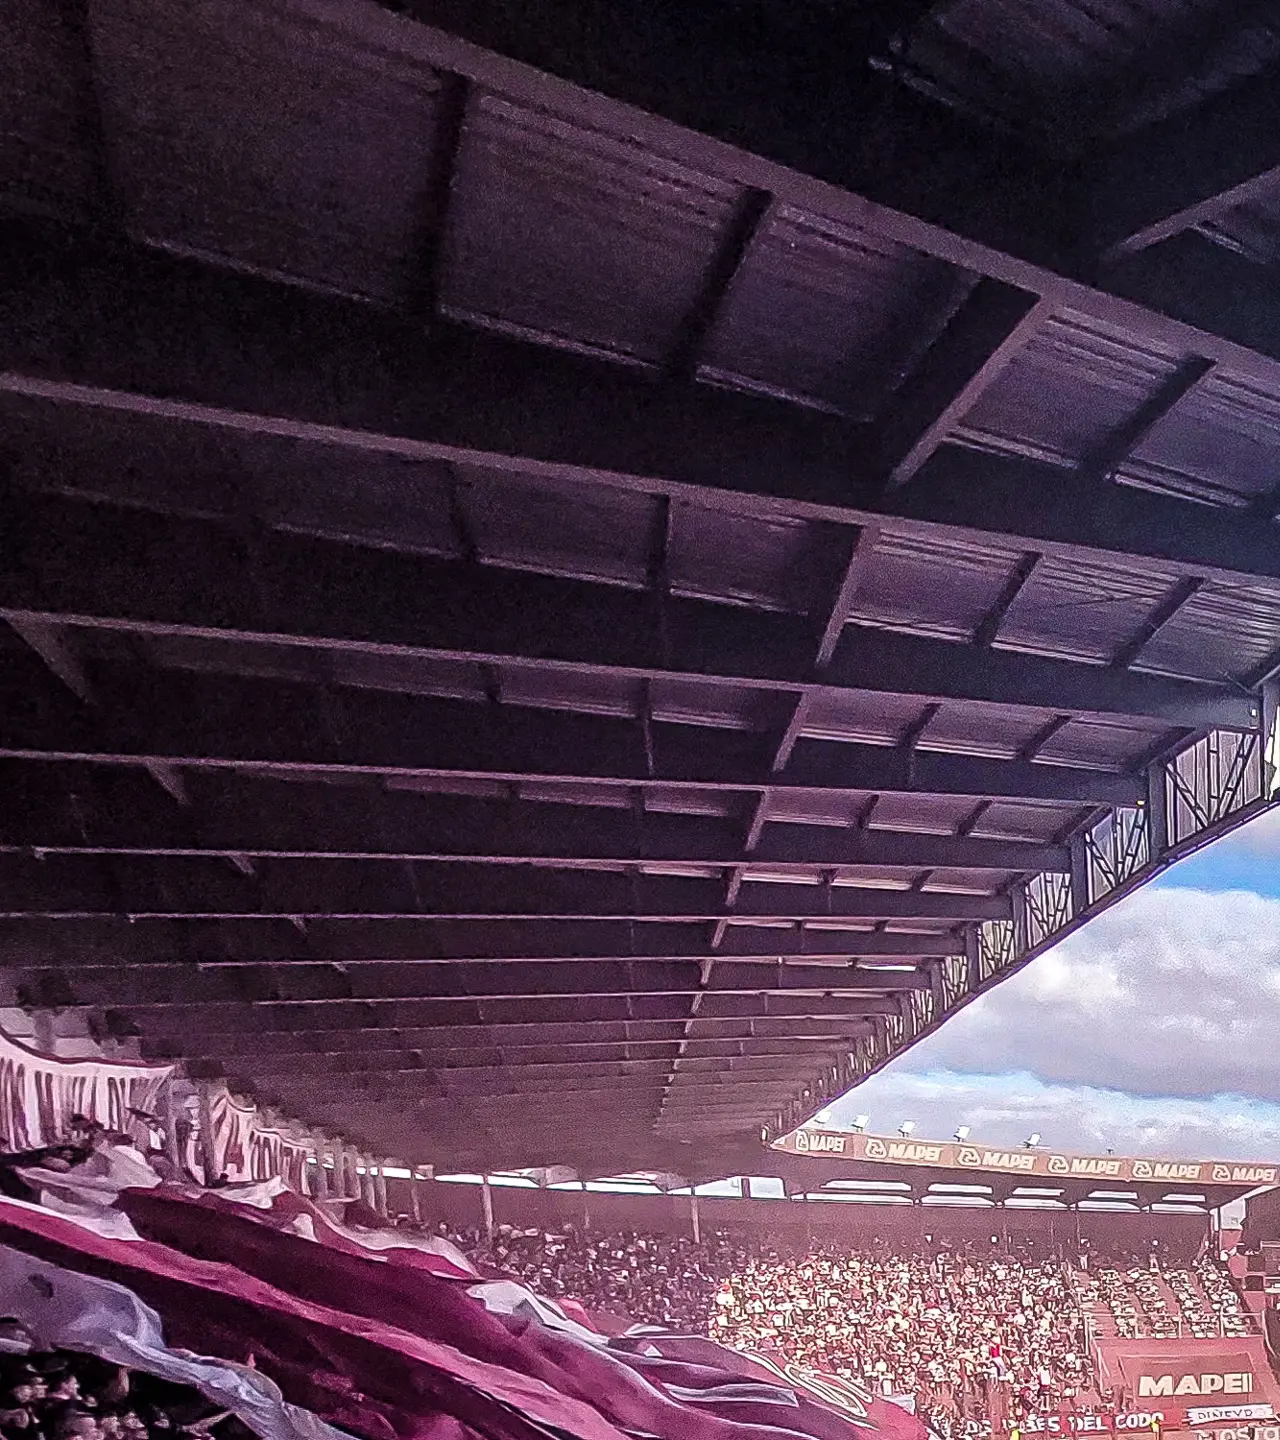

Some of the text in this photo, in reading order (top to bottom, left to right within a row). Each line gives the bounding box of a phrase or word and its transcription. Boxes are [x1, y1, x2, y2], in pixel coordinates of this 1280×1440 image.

[887, 1144, 943, 1162] MAPEI
[981, 1151, 1036, 1170] MAPEI
[1070, 1159, 1122, 1175] MAPEI
[1152, 1163, 1202, 1179] MAPEI
[1232, 1166, 1278, 1182] MAPEI
[1138, 1373, 1253, 1397] MAPEI
